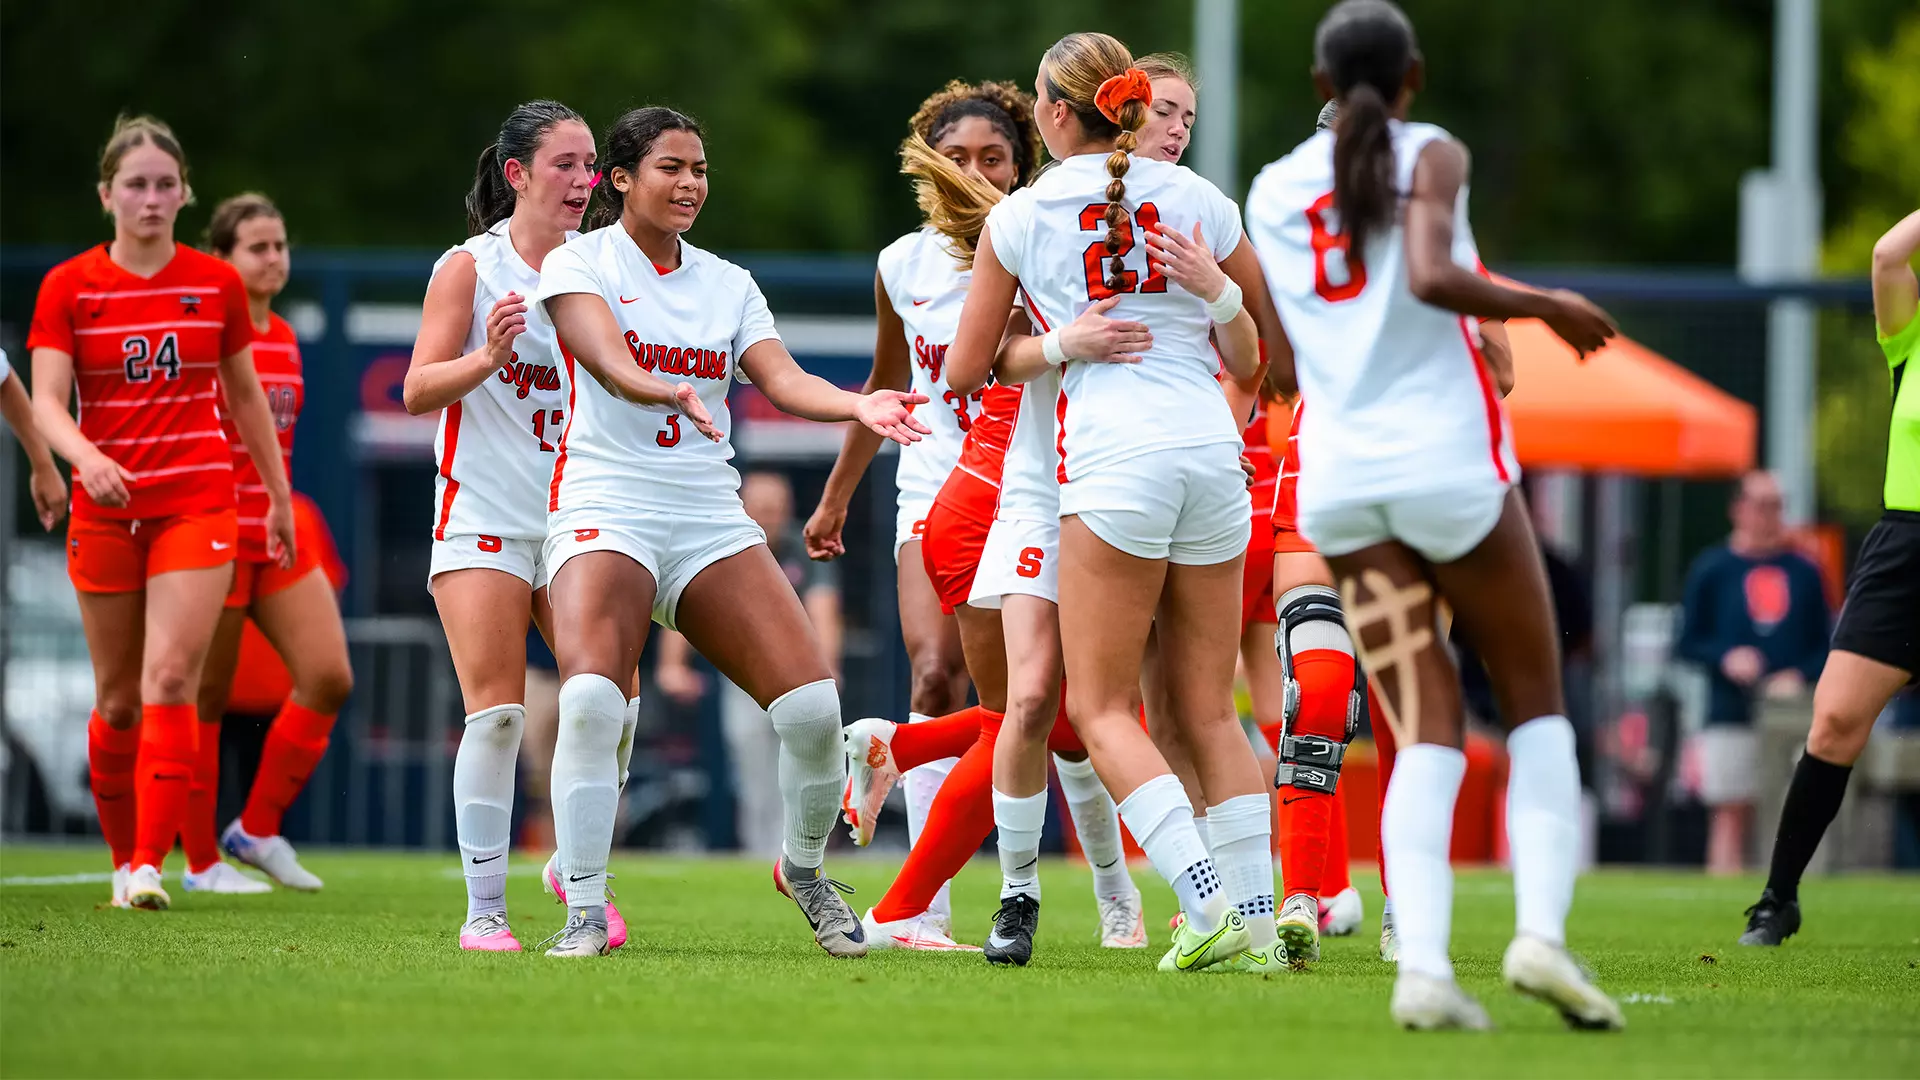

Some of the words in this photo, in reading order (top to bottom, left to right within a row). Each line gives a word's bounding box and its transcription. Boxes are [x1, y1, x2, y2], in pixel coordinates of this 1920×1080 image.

[1079, 201, 1167, 302] 21
[1304, 190, 1367, 303] 8
[123, 332, 182, 384] 24
[624, 329, 727, 381] Syracuse
[656, 413, 681, 449] 3
[1016, 547, 1045, 578] S
